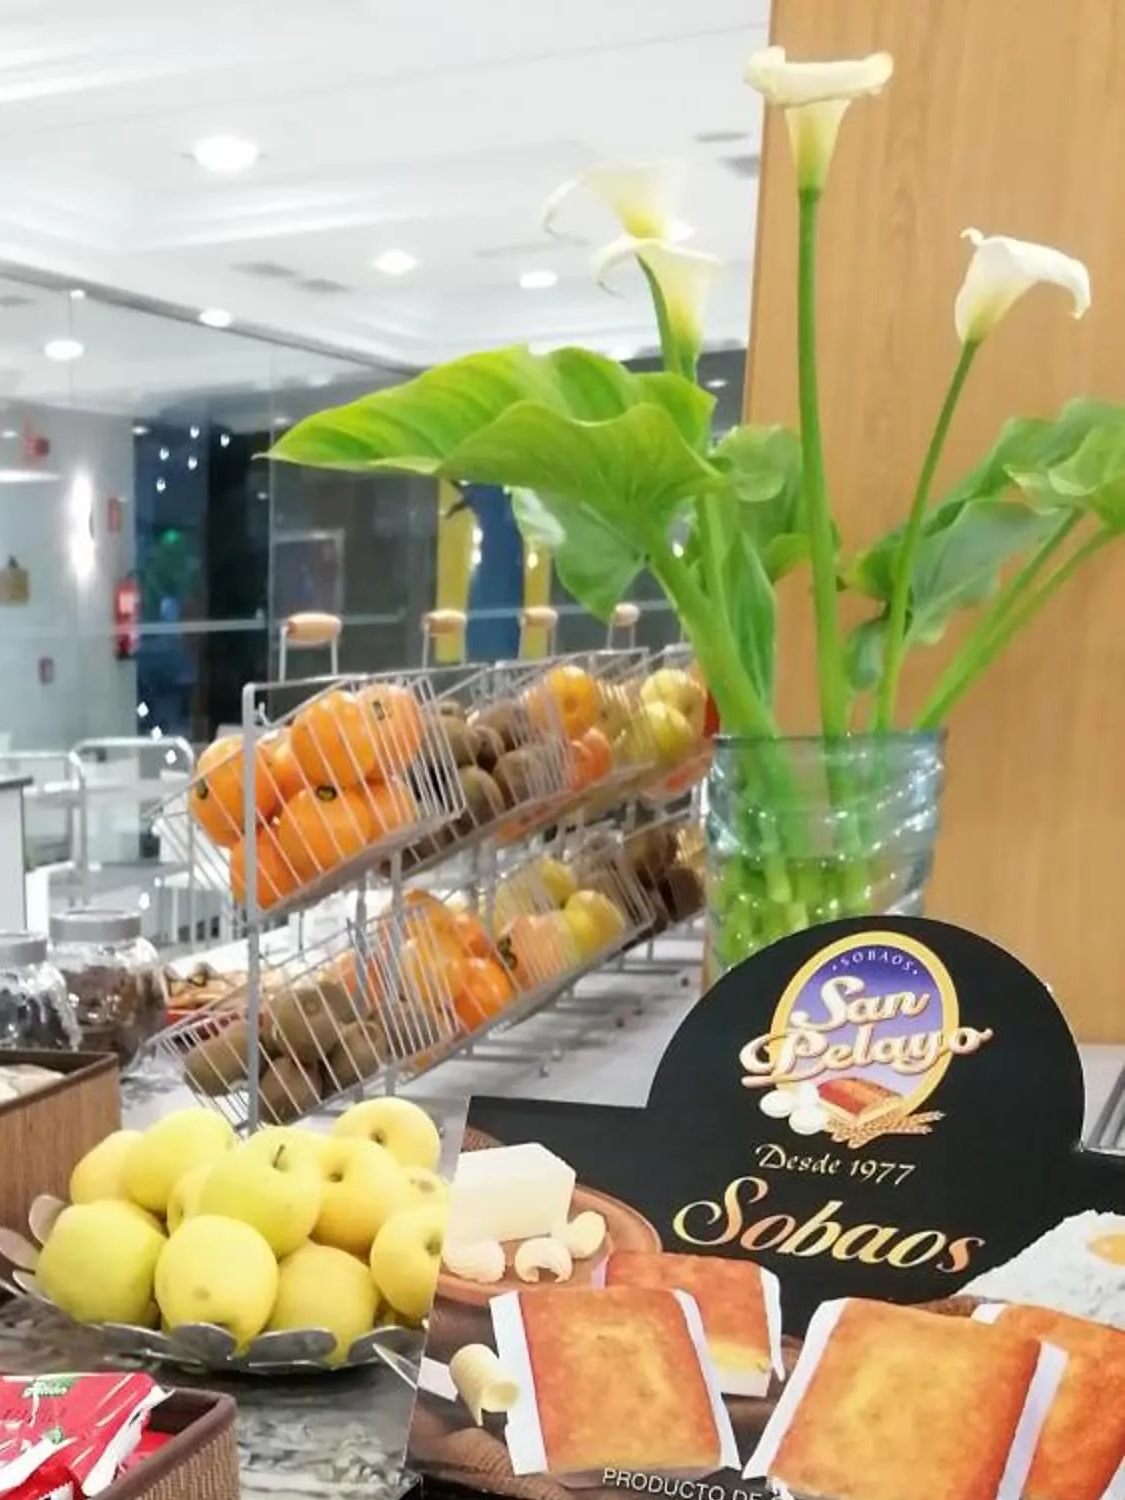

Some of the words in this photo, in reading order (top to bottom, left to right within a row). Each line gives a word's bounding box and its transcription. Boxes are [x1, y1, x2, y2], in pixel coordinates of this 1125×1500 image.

[840, 949, 912, 972] SOBAOS
[789, 975, 930, 1032] San
[739, 1022, 993, 1087] Pelayo
[754, 1143, 841, 1175] Desde
[850, 1158, 916, 1186] 1977
[673, 1176, 985, 1272] Sobaos
